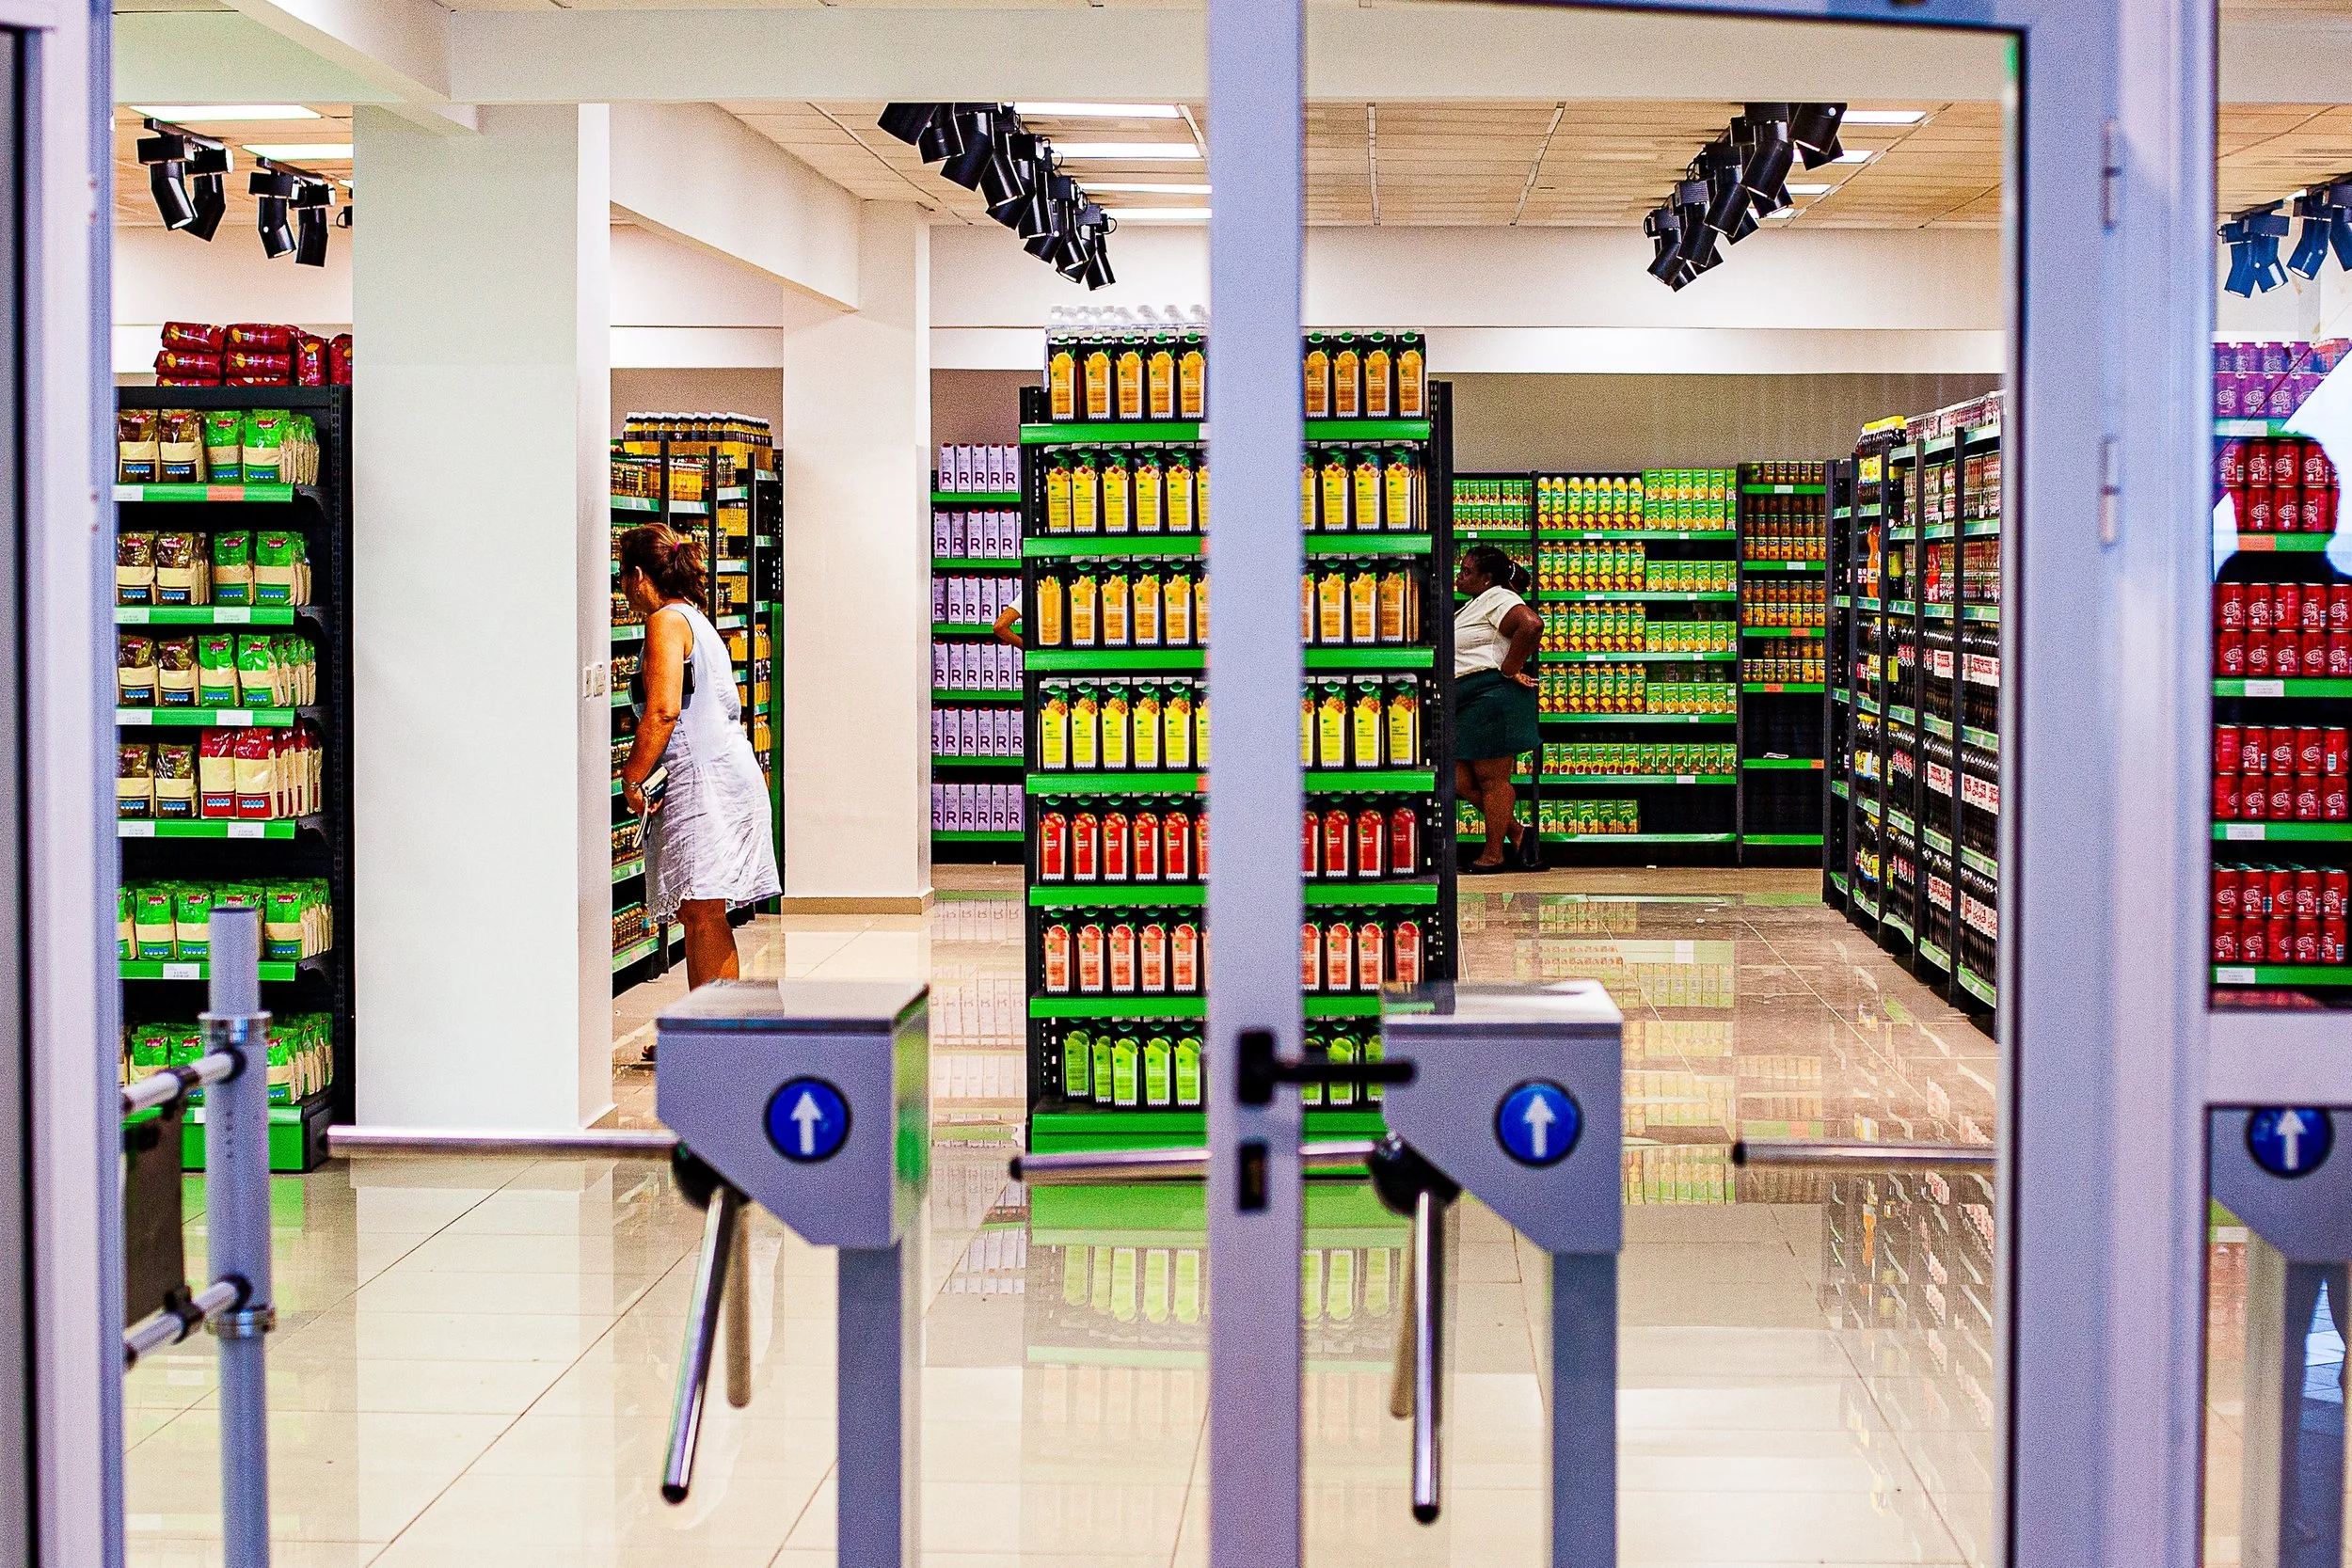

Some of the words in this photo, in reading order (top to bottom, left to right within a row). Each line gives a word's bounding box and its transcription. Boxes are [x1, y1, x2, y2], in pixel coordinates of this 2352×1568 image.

[942, 472, 952, 484] R
[960, 472, 969, 483] R
[975, 472, 984, 483] R
[991, 472, 1000, 484] R
[1006, 472, 1015, 483] R
[937, 537, 946, 549] R
[953, 537, 964, 550] R
[971, 538, 980, 549] R
[987, 538, 996, 549] R
[1003, 538, 1012, 550] R
[934, 604, 945, 616] R
[951, 604, 960, 615] R
[966, 604, 975, 615] R
[981, 604, 992, 616] R
[934, 669, 945, 681] R
[952, 669, 961, 681] R
[967, 670, 977, 681] R
[984, 670, 993, 682] R
[1000, 670, 1009, 682] R
[946, 736, 956, 748] R
[963, 736, 973, 748] R
[980, 736, 990, 748] R
[996, 736, 1007, 748] R
[1012, 736, 1023, 749] R
[946, 811, 957, 823] R
[962, 811, 972, 823] R
[977, 811, 988, 824] R
[993, 811, 1004, 824] R
[1009, 812, 1019, 824] R
